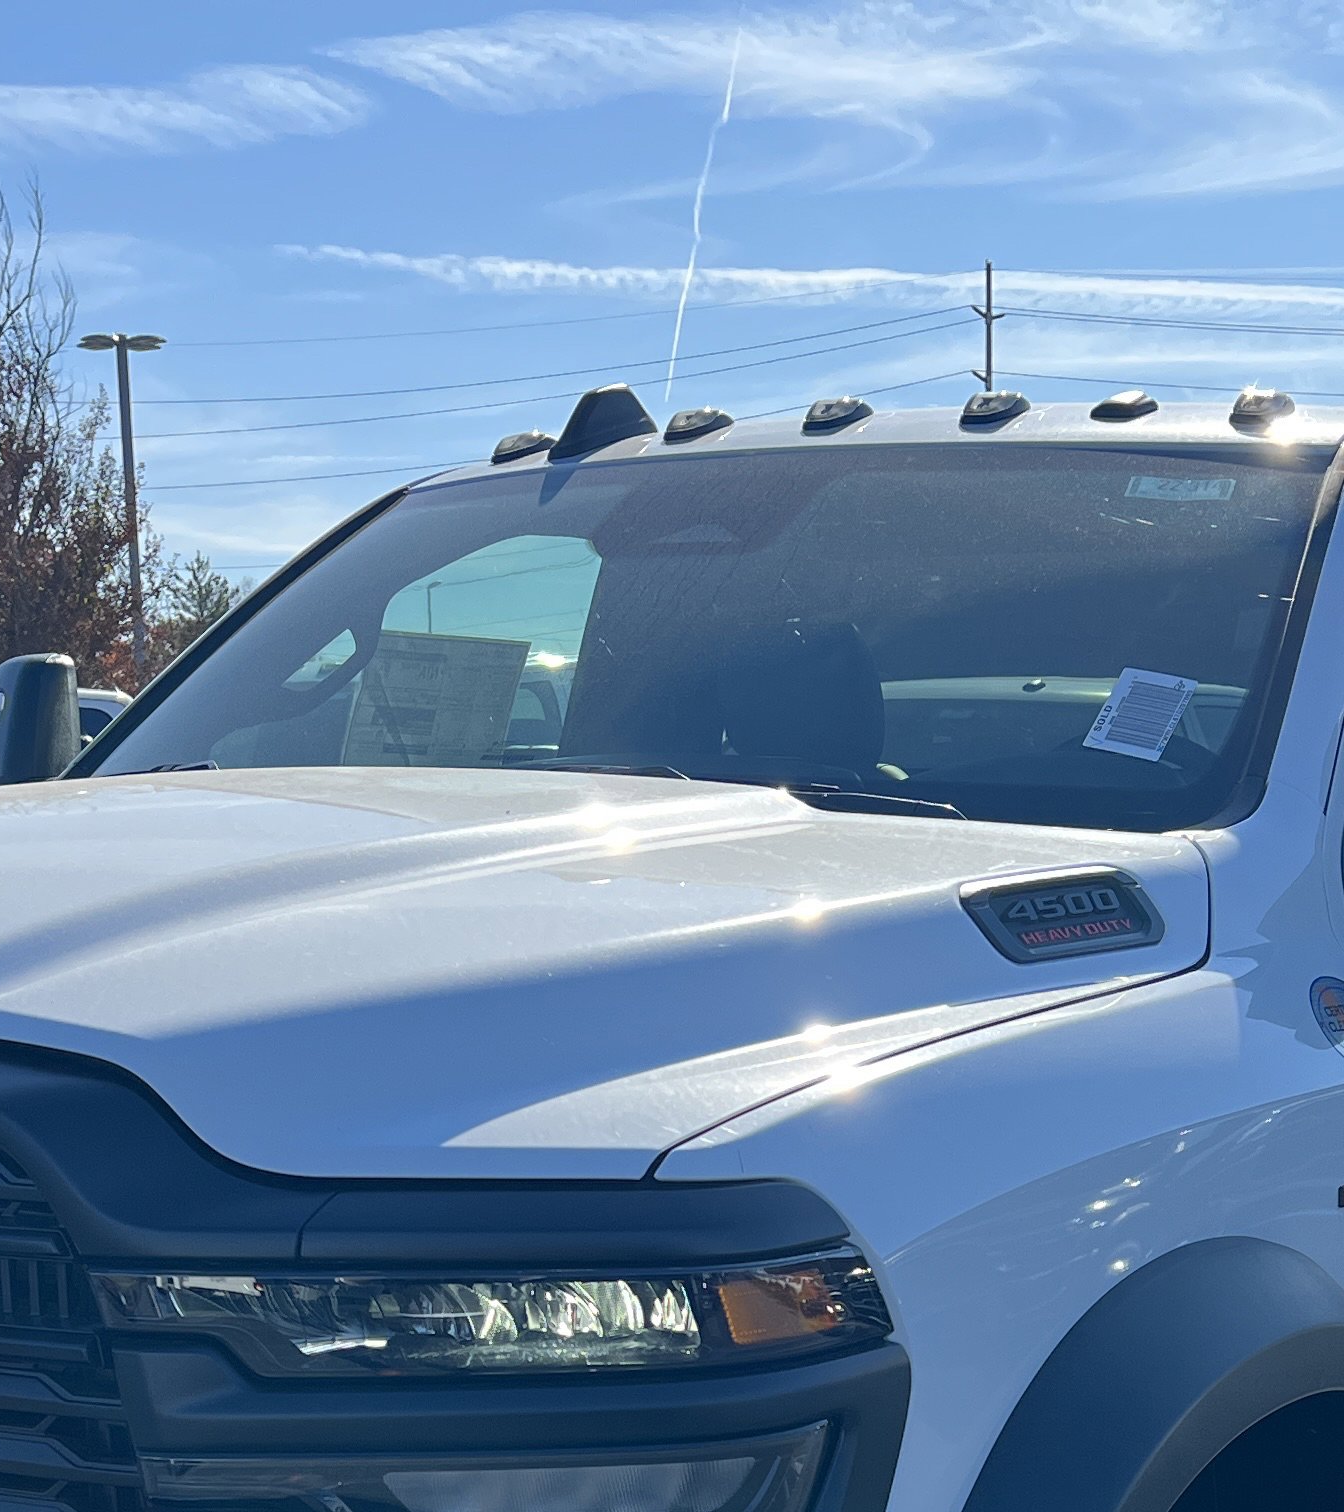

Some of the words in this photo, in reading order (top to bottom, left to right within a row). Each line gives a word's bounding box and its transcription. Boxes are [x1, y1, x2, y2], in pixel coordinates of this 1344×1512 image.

[1094, 704, 1113, 732] SOLD
[1008, 888, 1121, 921] 4500
[1021, 926, 1082, 945] HEAVY
[1083, 918, 1132, 937] DUTY
